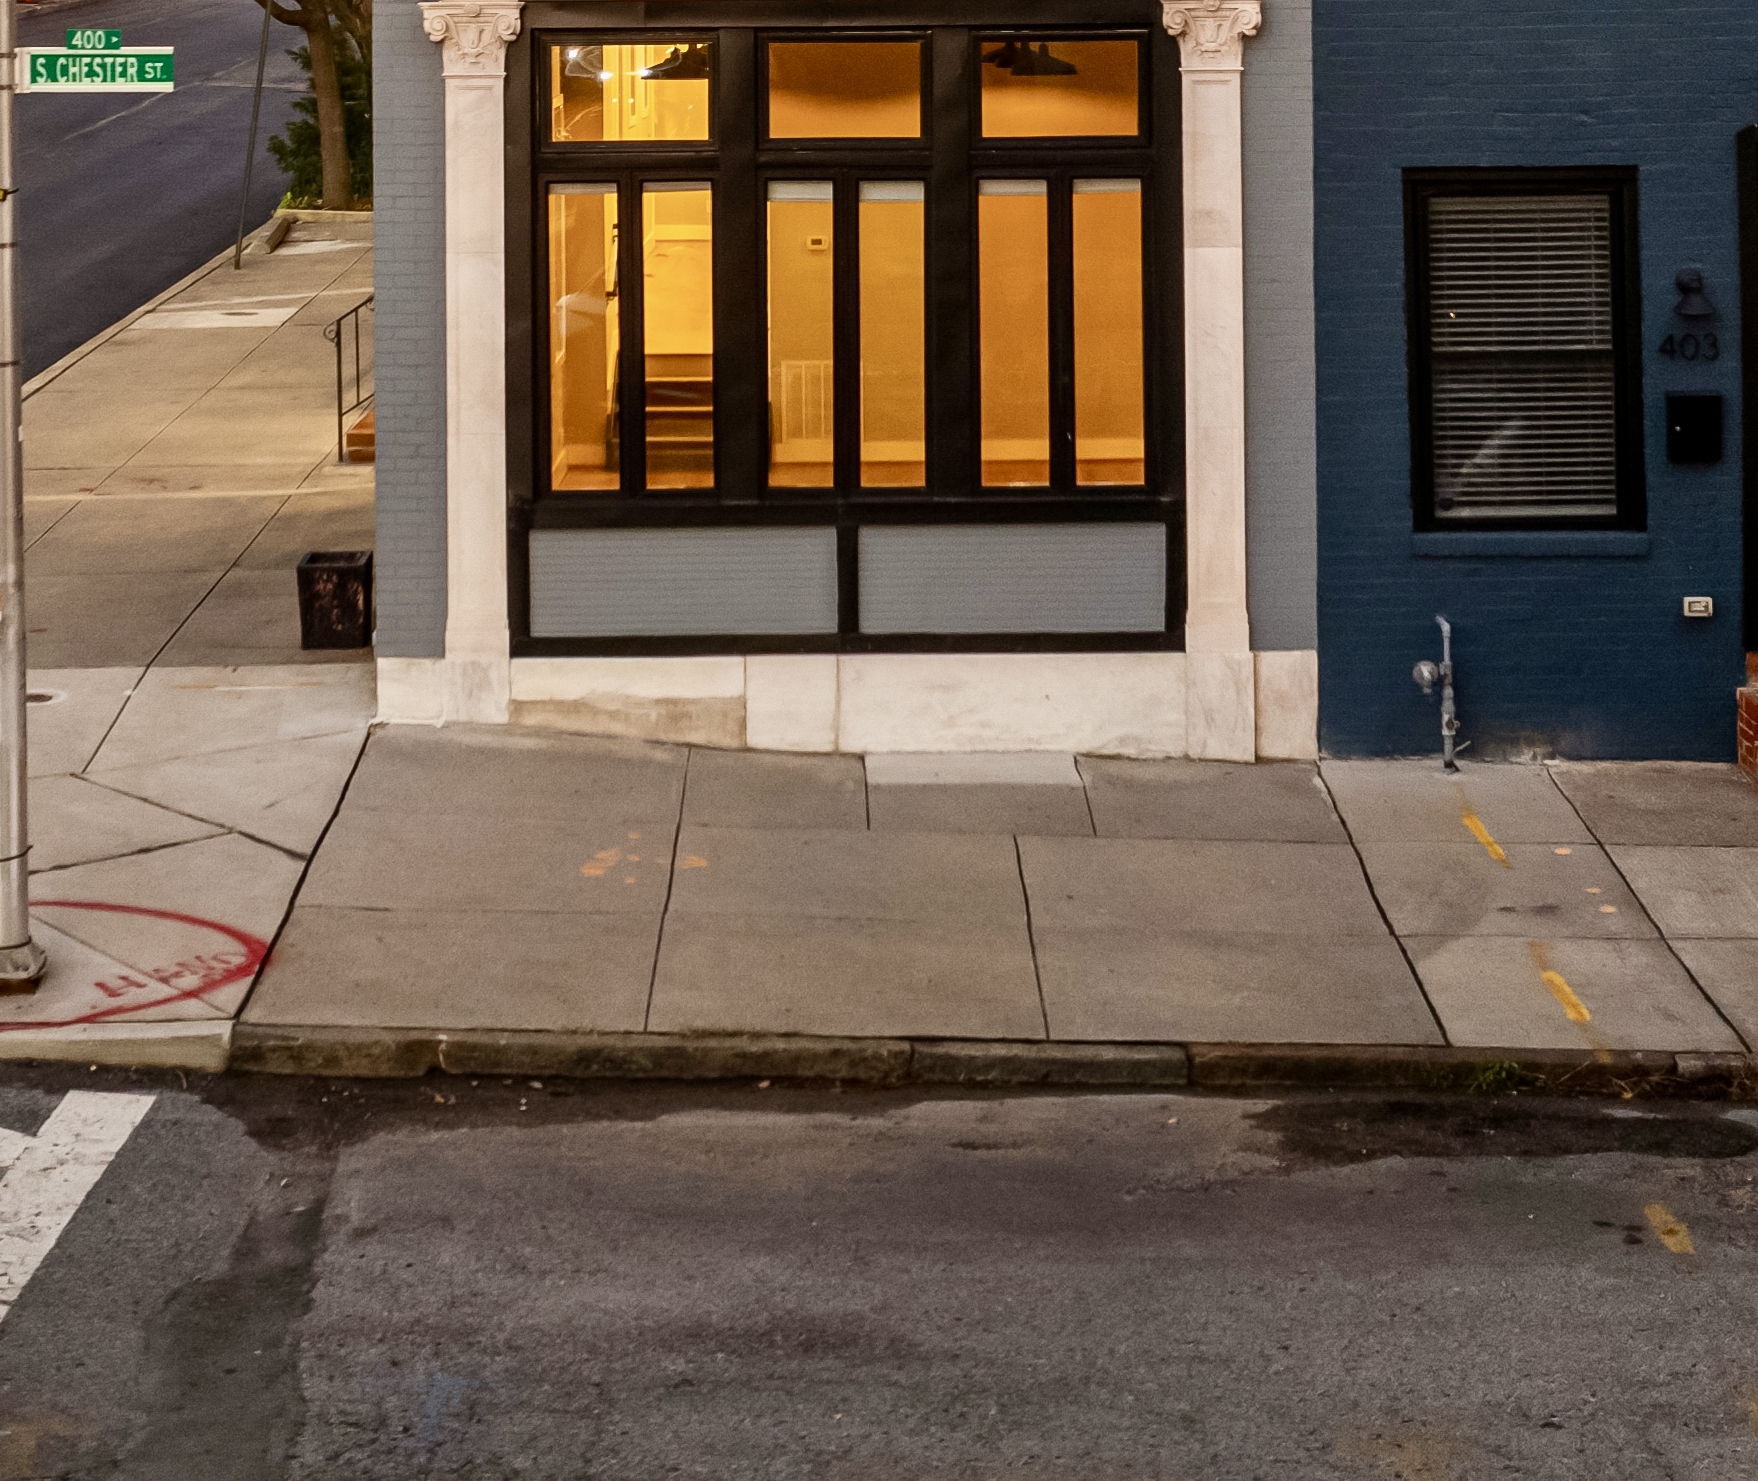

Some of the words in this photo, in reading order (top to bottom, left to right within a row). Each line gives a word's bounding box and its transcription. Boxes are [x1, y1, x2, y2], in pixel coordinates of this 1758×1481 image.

[71, 30, 105, 49] 400
[35, 57, 51, 83] S.
[56, 57, 138, 83] CHESTER
[1659, 332, 1720, 361] 403
